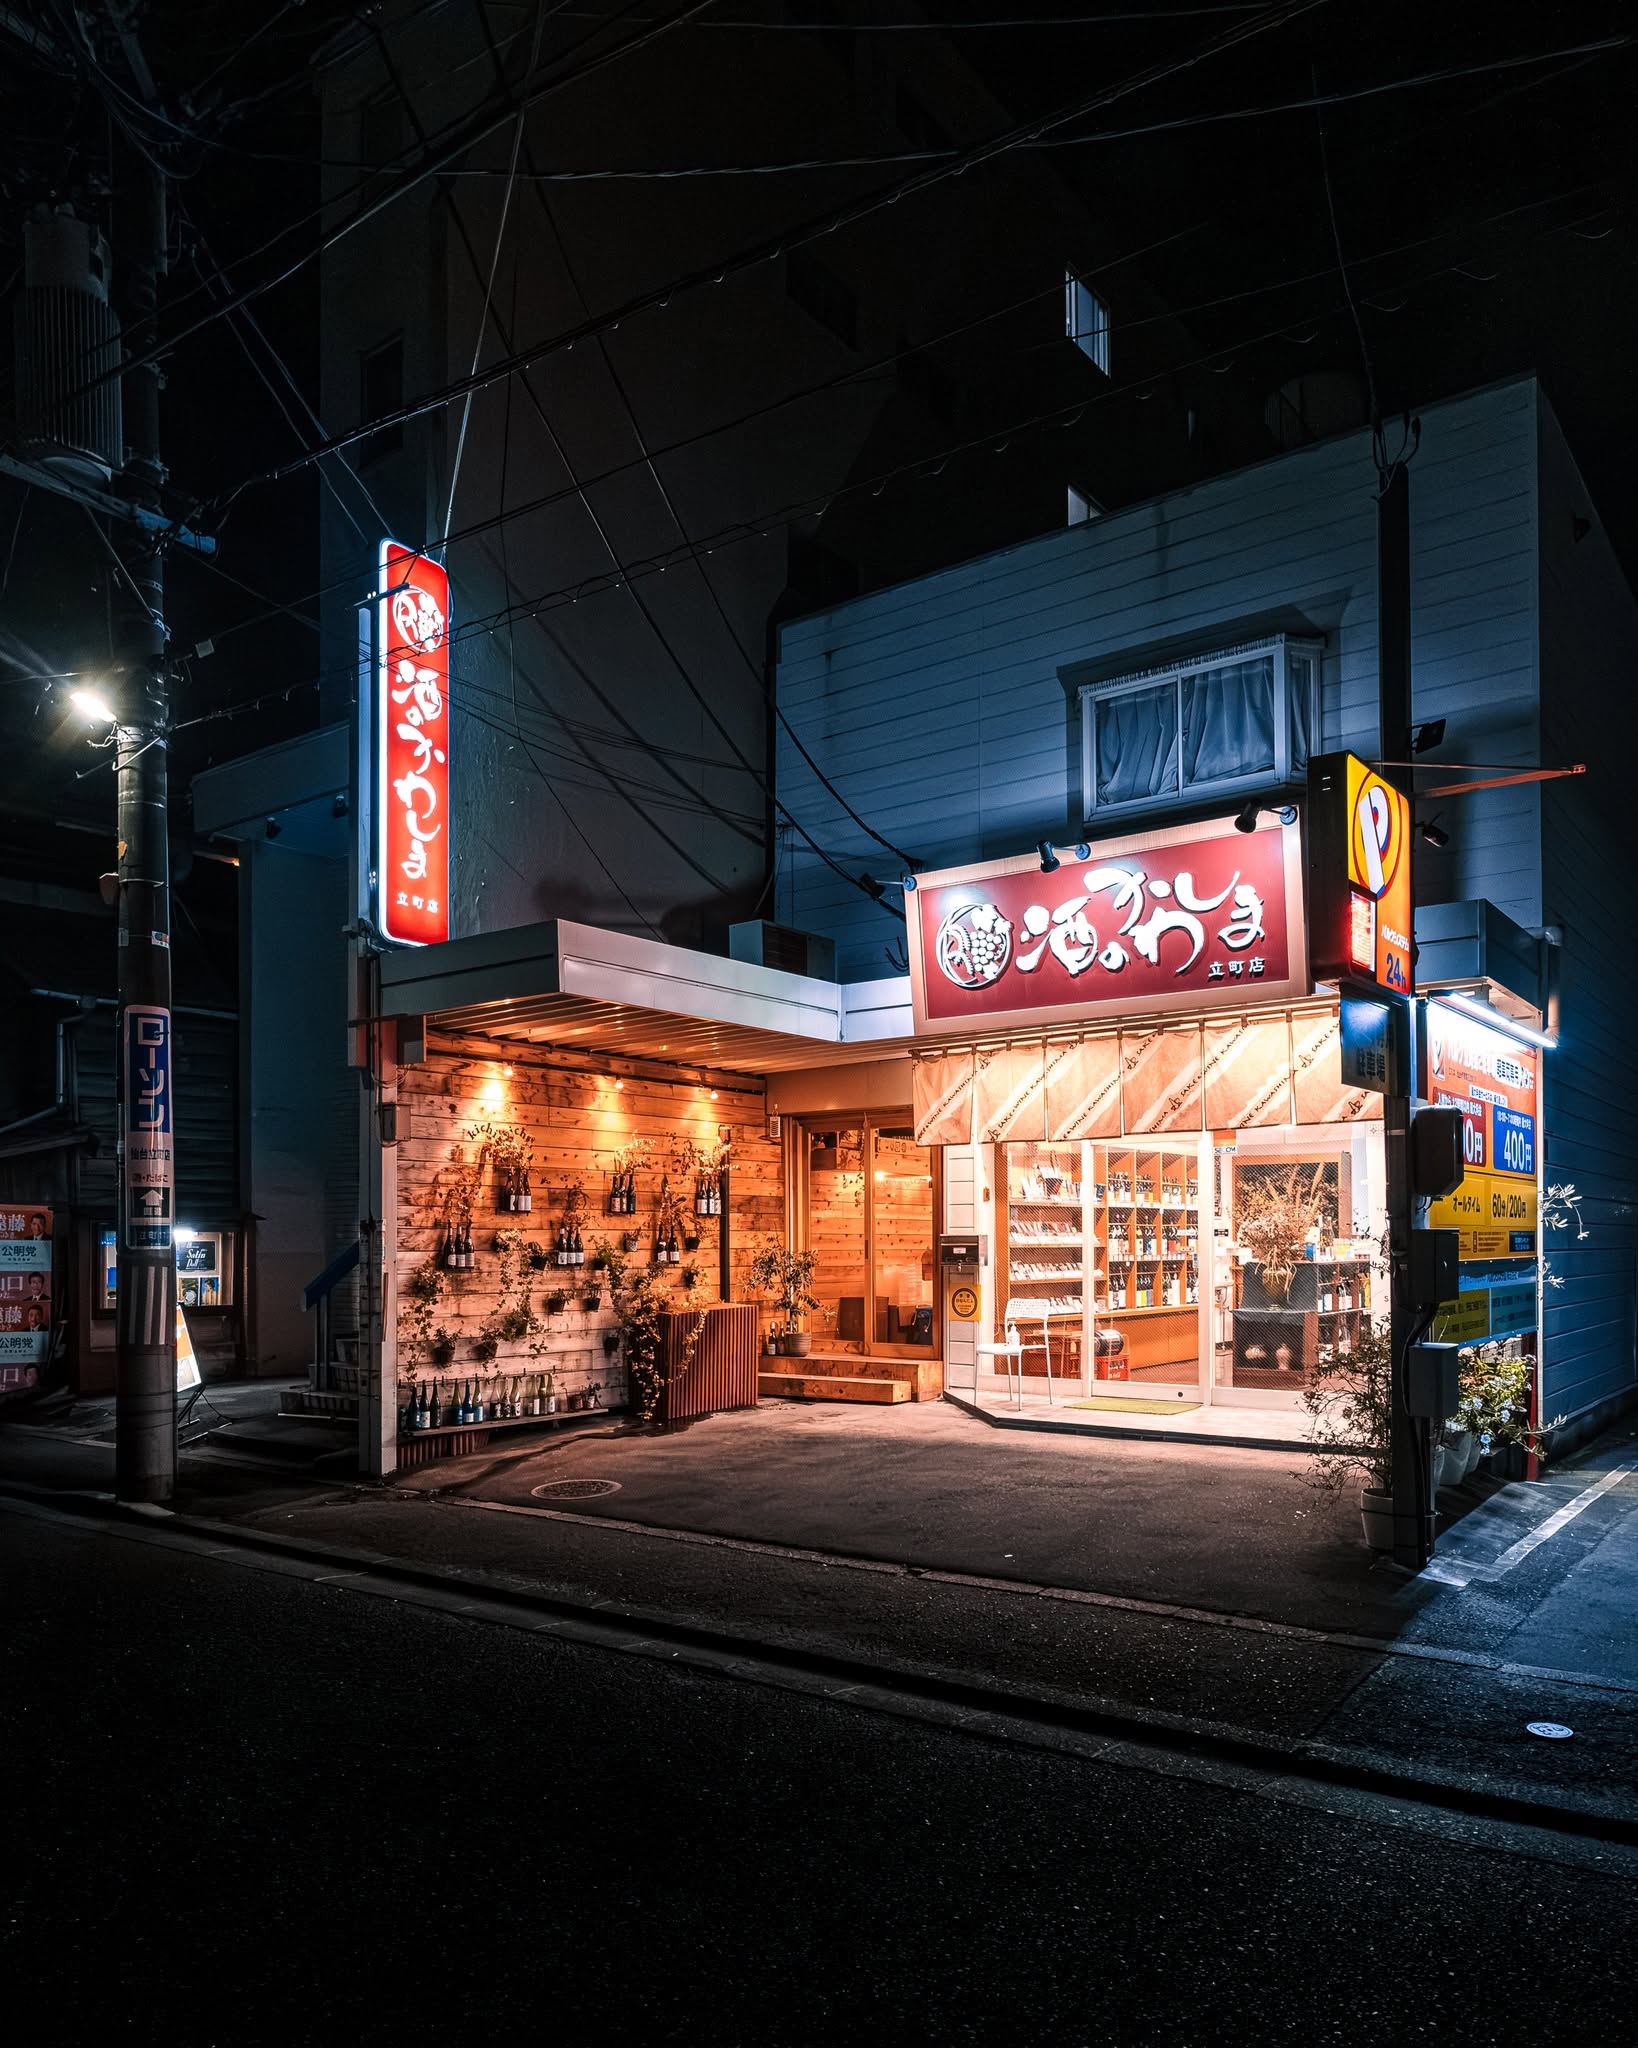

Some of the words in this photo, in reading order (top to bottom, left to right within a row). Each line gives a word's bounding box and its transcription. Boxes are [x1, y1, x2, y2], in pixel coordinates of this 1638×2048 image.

[391, 658, 446, 880] 酒のかわしま
[396, 890, 440, 914] 立町店
[1015, 865, 1266, 977] 酒のかわしま
[1208, 955, 1266, 980] 立町店
[137, 1017, 165, 1128] ローソン
[1504, 1129, 1532, 1172] 400円
[1453, 1195, 1481, 1213] オールタイム
[1492, 1193, 1526, 1219] 60分/200円
[2, 1245, 37, 1257] 公明党
[0, 1337, 34, 1349] 公明党
